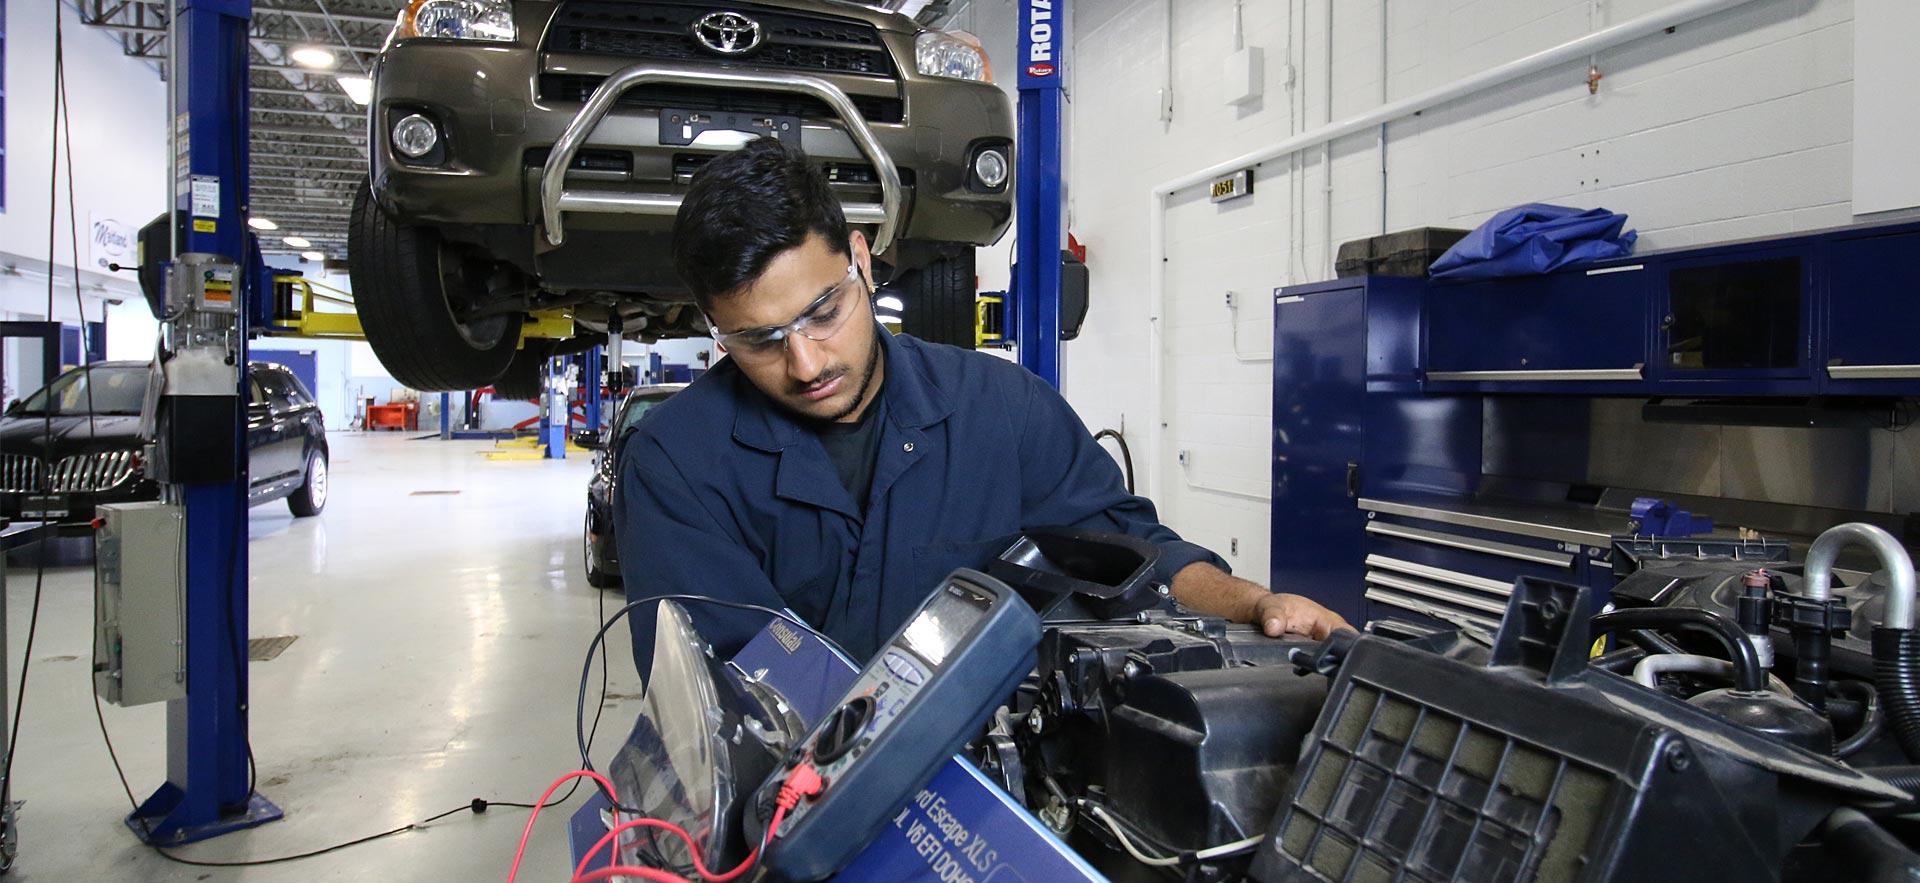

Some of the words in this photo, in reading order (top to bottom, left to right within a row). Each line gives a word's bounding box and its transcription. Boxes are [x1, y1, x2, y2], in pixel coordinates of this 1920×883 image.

[769, 617, 804, 652] Consulab
[905, 819, 926, 844] V6
[916, 833, 943, 863] EFI
[926, 797, 968, 847] Escape
[961, 833, 997, 872] XLS
